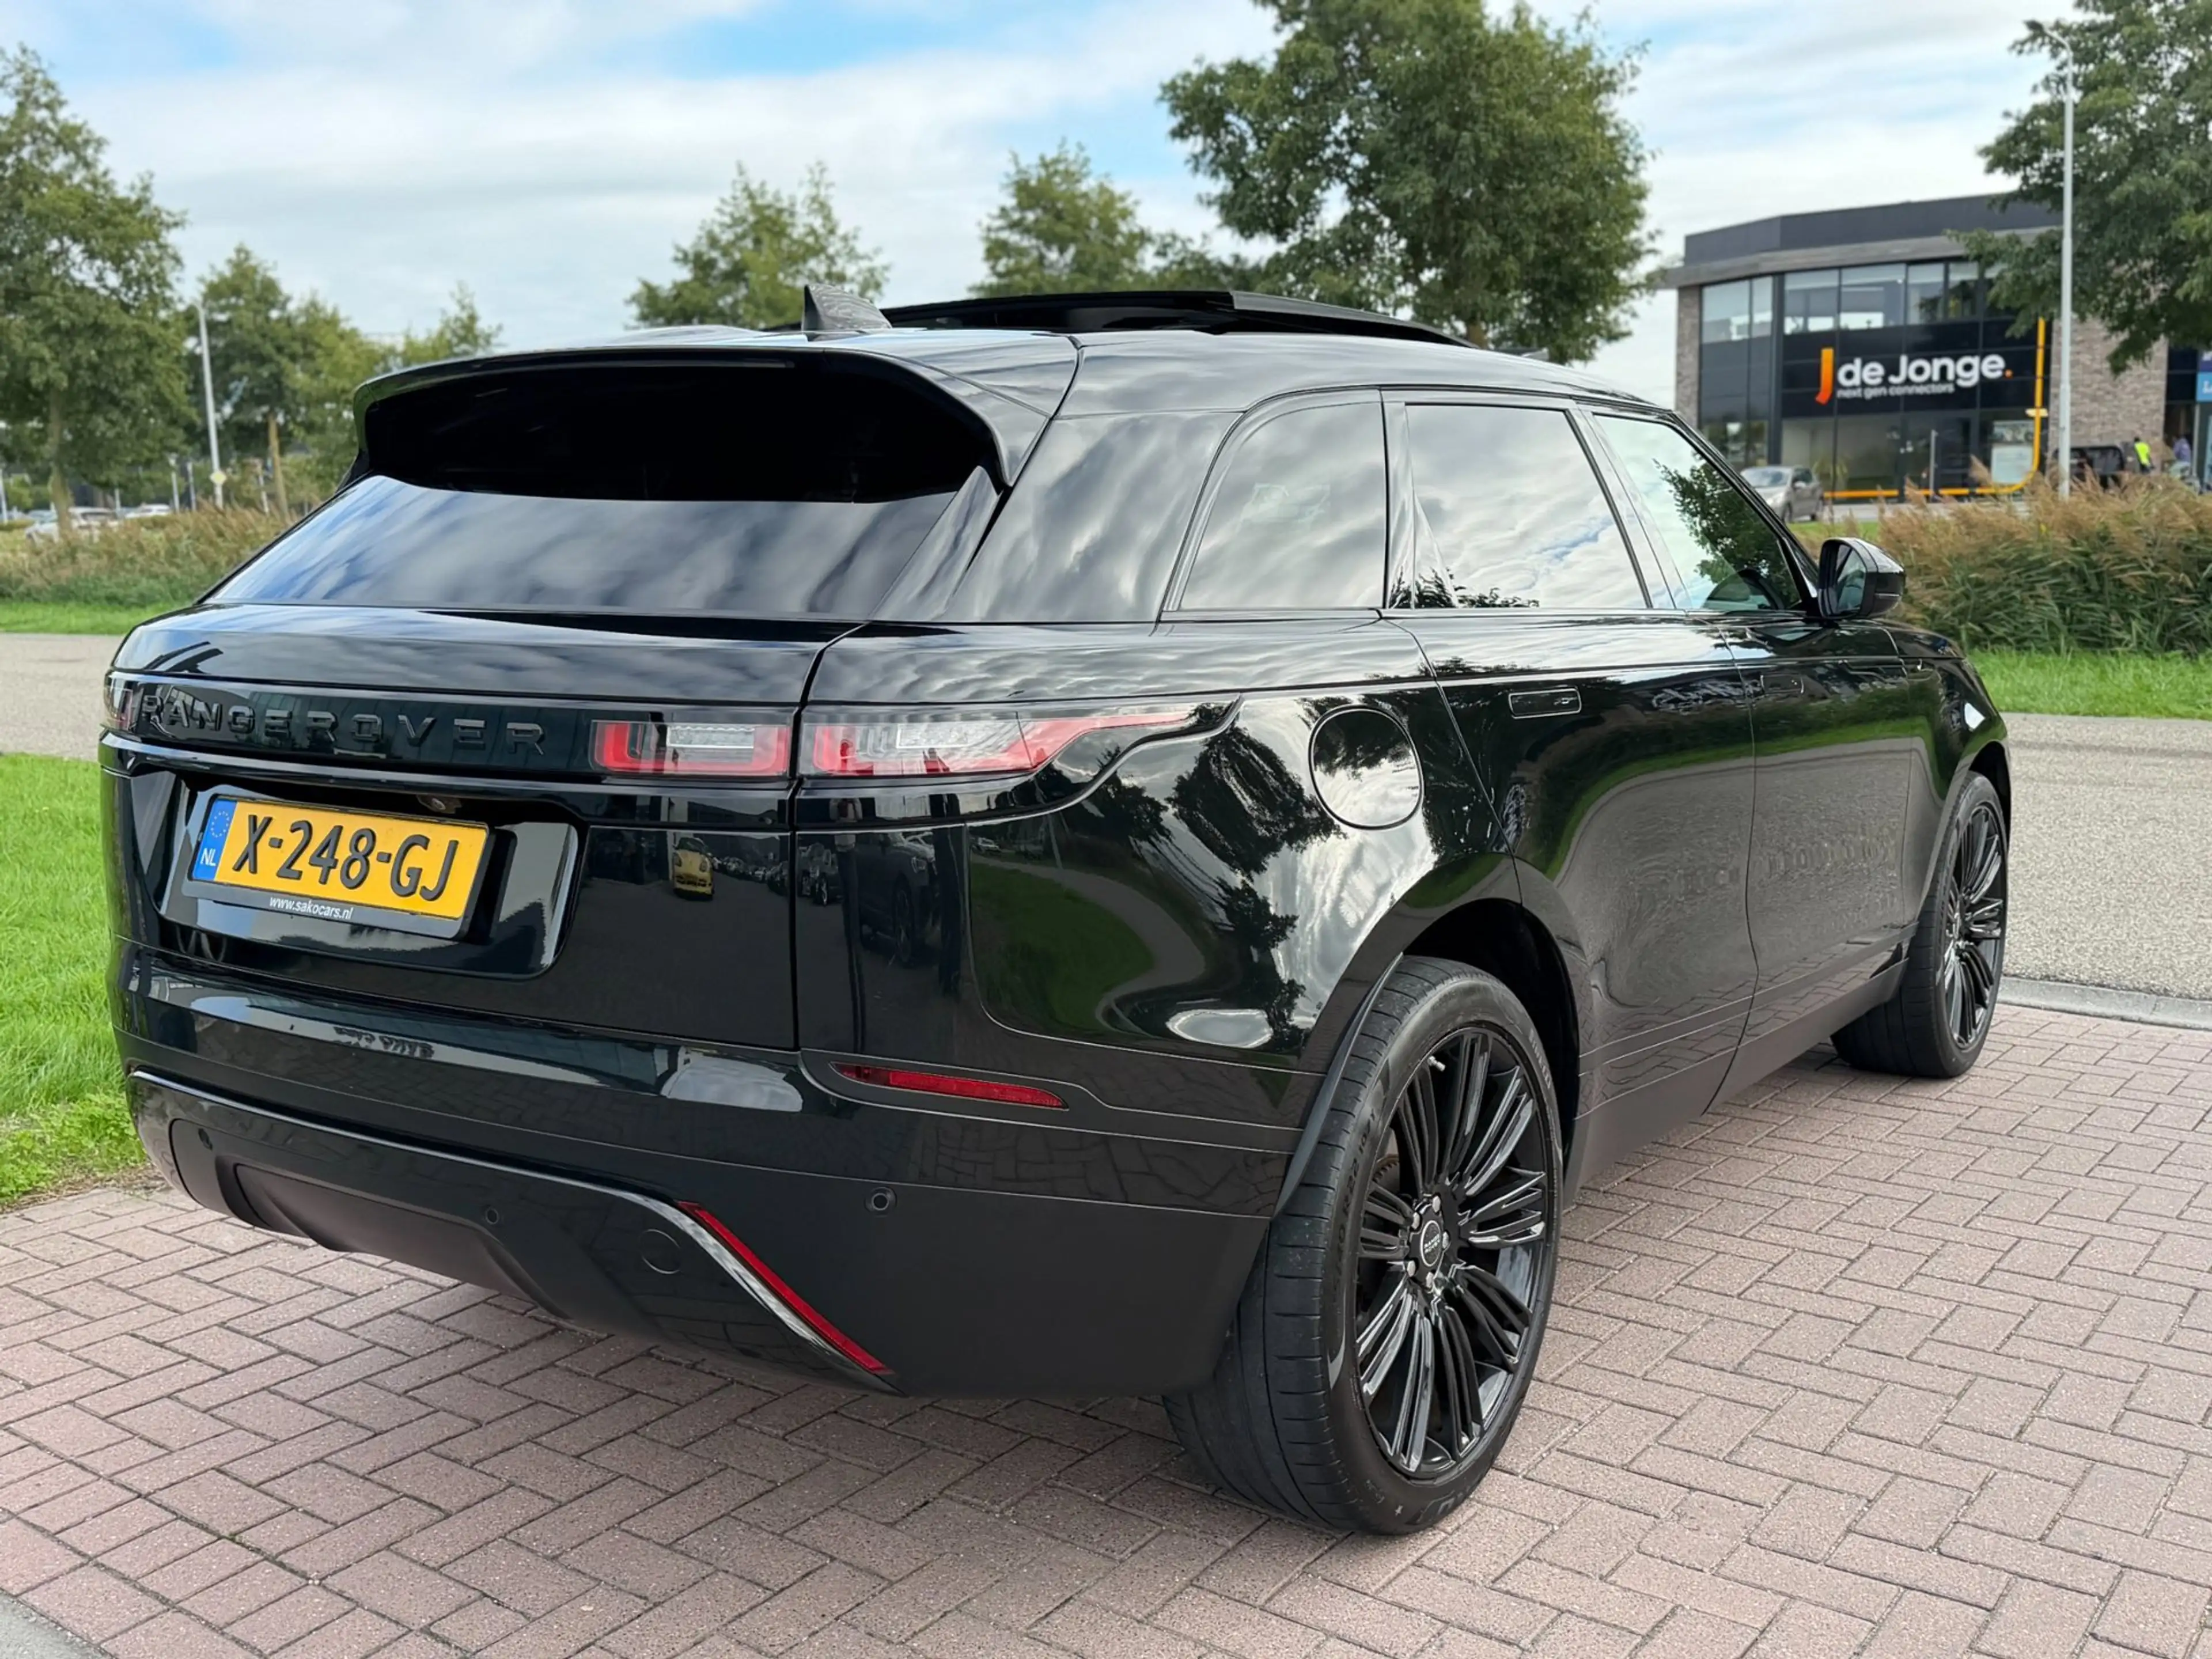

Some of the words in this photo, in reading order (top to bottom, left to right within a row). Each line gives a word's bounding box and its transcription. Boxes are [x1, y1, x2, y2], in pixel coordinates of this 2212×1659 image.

[1837, 357, 1885, 387] de
[1836, 387, 1863, 399] next
[1863, 386, 1887, 400] gen
[1888, 382, 1955, 396] connectors
[141, 695, 294, 742] RANGE
[306, 710, 546, 756] ROVER
[200, 847, 217, 867] NL
[232, 814, 459, 902] X-248-GJ
[269, 896, 354, 920] www.sakocars.nl
